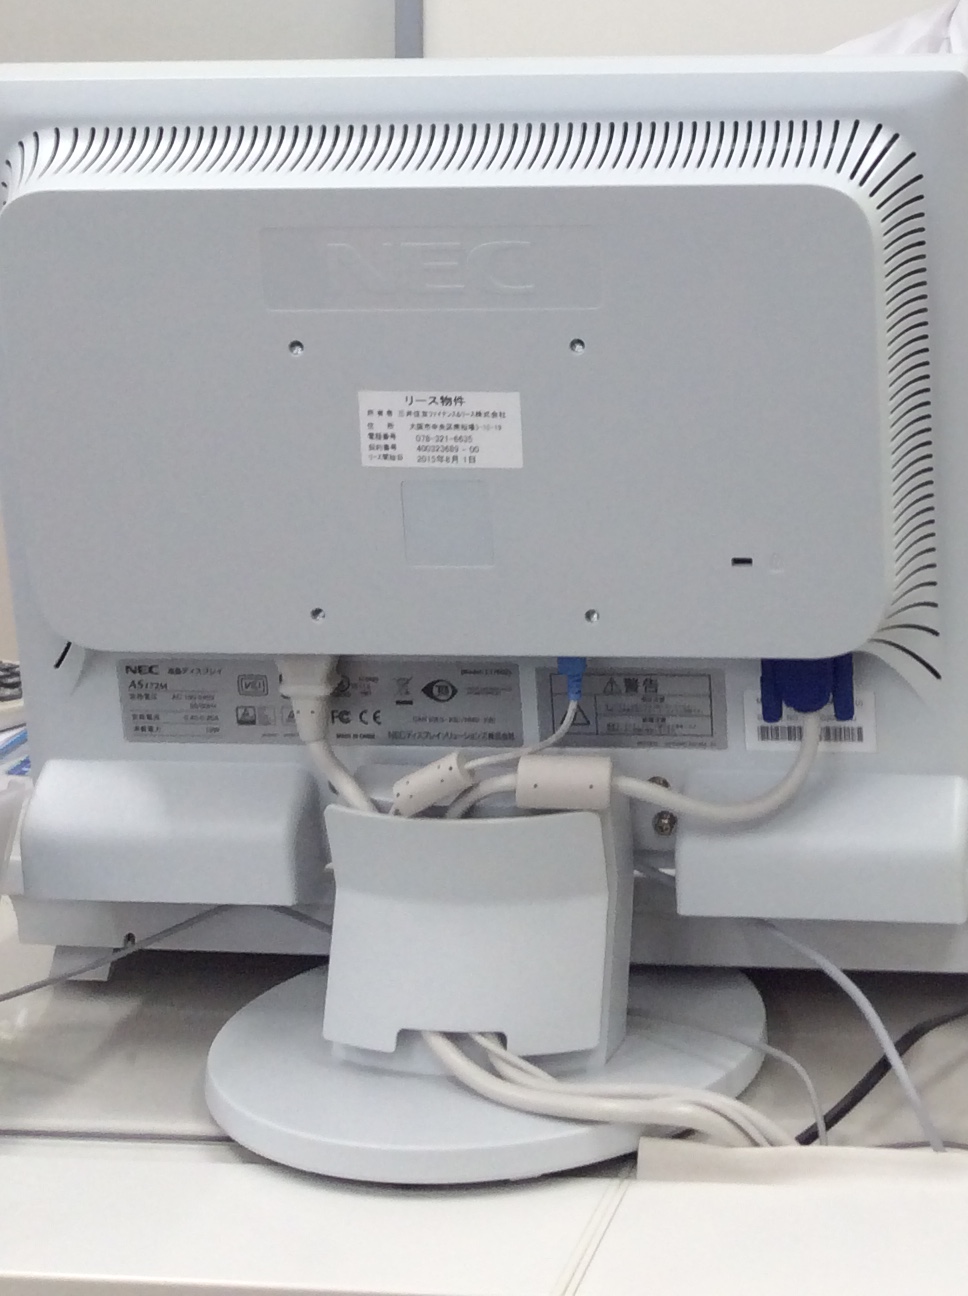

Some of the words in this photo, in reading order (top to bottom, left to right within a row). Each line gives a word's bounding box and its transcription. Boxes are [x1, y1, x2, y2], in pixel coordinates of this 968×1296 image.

[405, 396, 465, 406] リース物件
[126, 665, 159, 675] NEC
[624, 678, 658, 693] 警告
